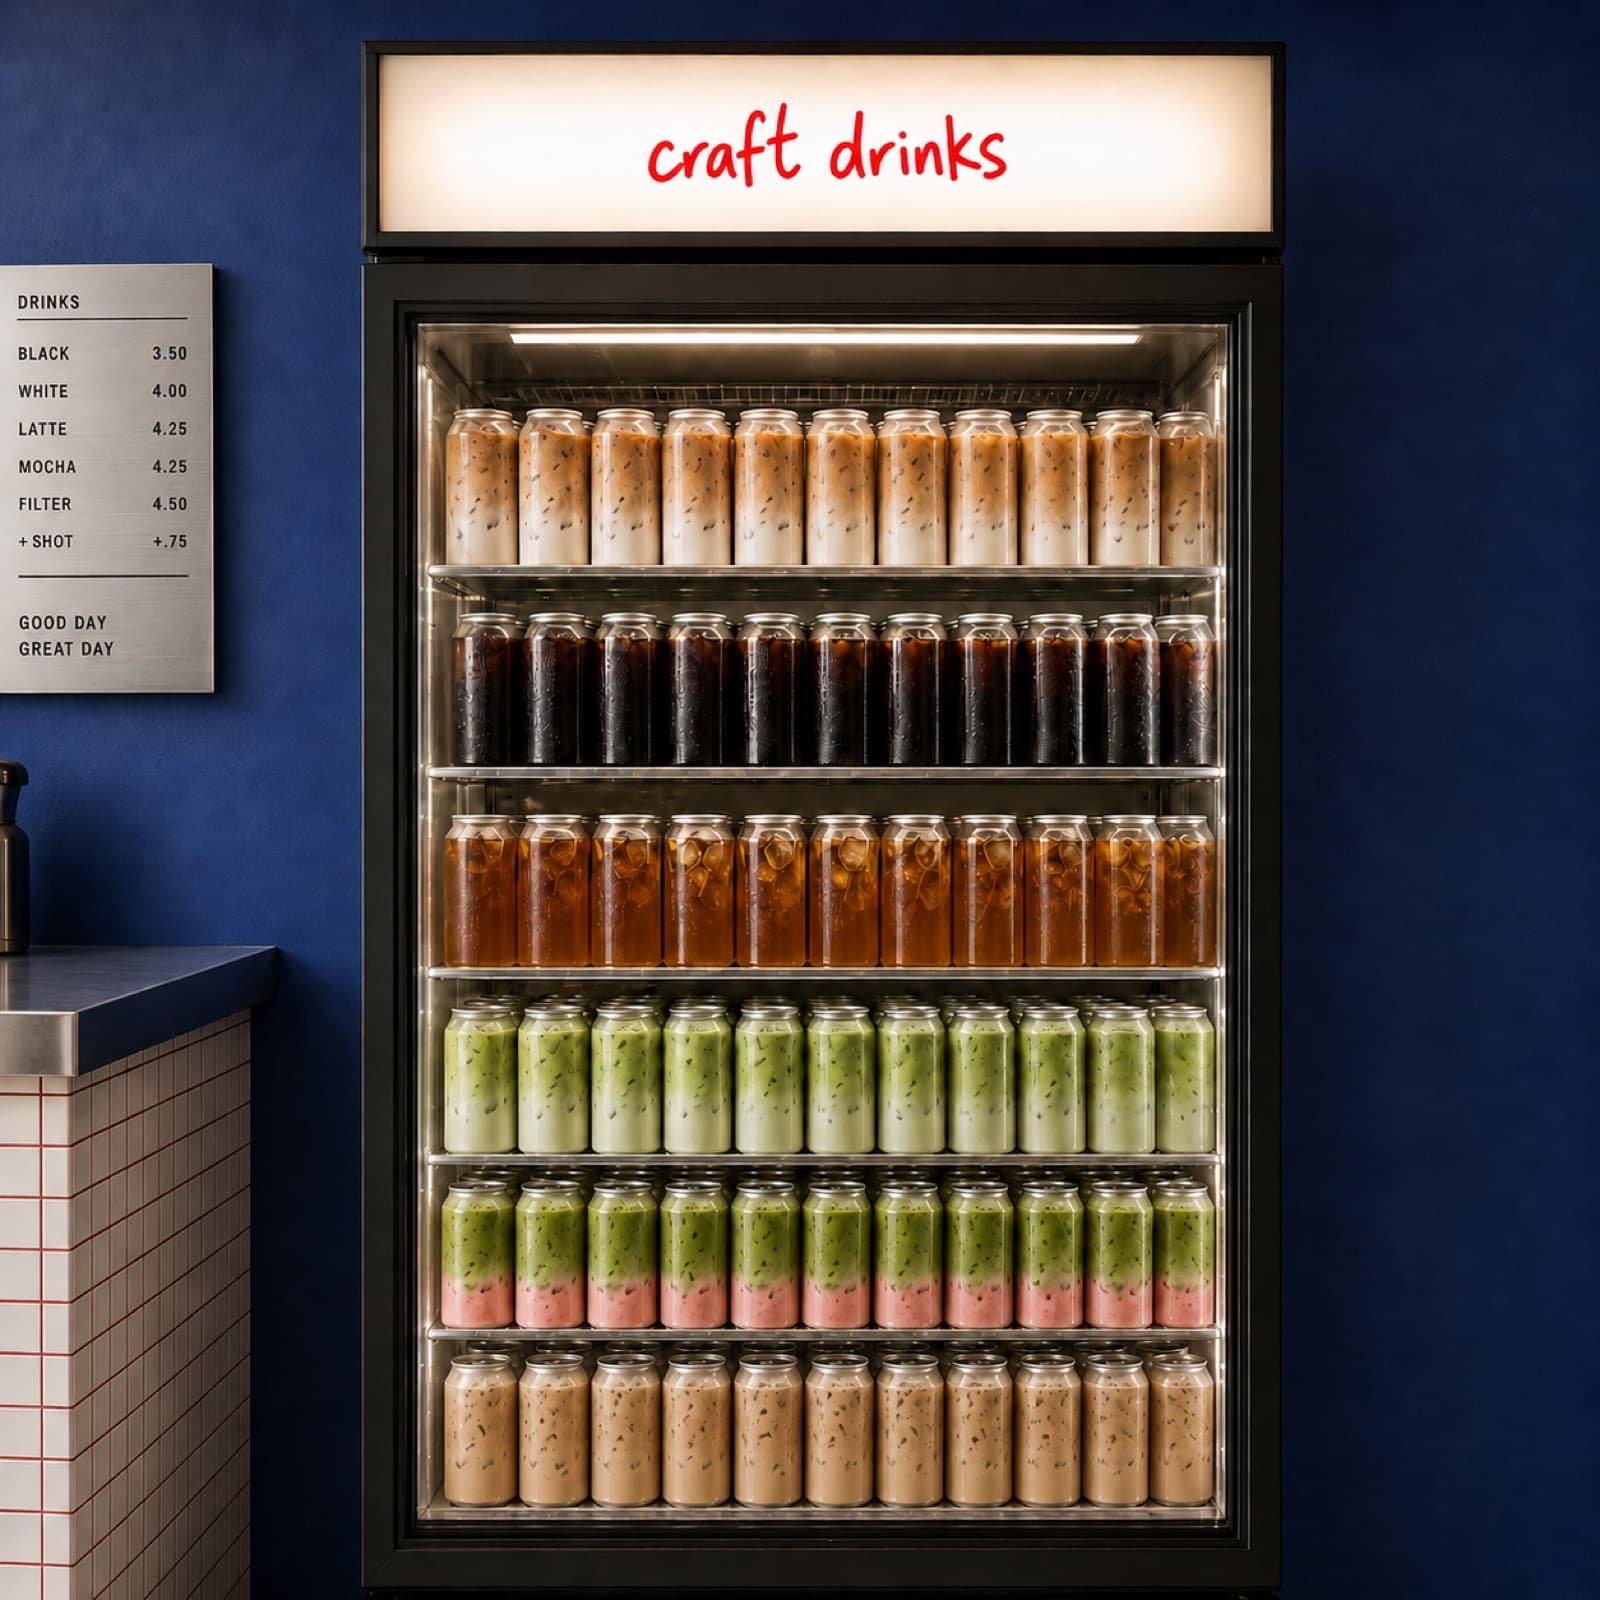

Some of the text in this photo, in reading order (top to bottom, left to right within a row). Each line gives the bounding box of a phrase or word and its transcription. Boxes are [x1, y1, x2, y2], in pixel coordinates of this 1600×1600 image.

[648, 103, 1006, 187] craft drinks
[18, 294, 80, 310] DRINKS
[18, 345, 188, 361] BLACK 3.50
[18, 383, 188, 399] WHITE 4.00
[18, 421, 187, 437] LATTE 4.25
[18, 458, 188, 475] MOCHA 4.25
[18, 496, 188, 511] FILTER 4.50
[152, 534, 188, 549] +.75
[18, 614, 107, 631] GOOD DAY
[18, 640, 114, 657] GREAT DAY
